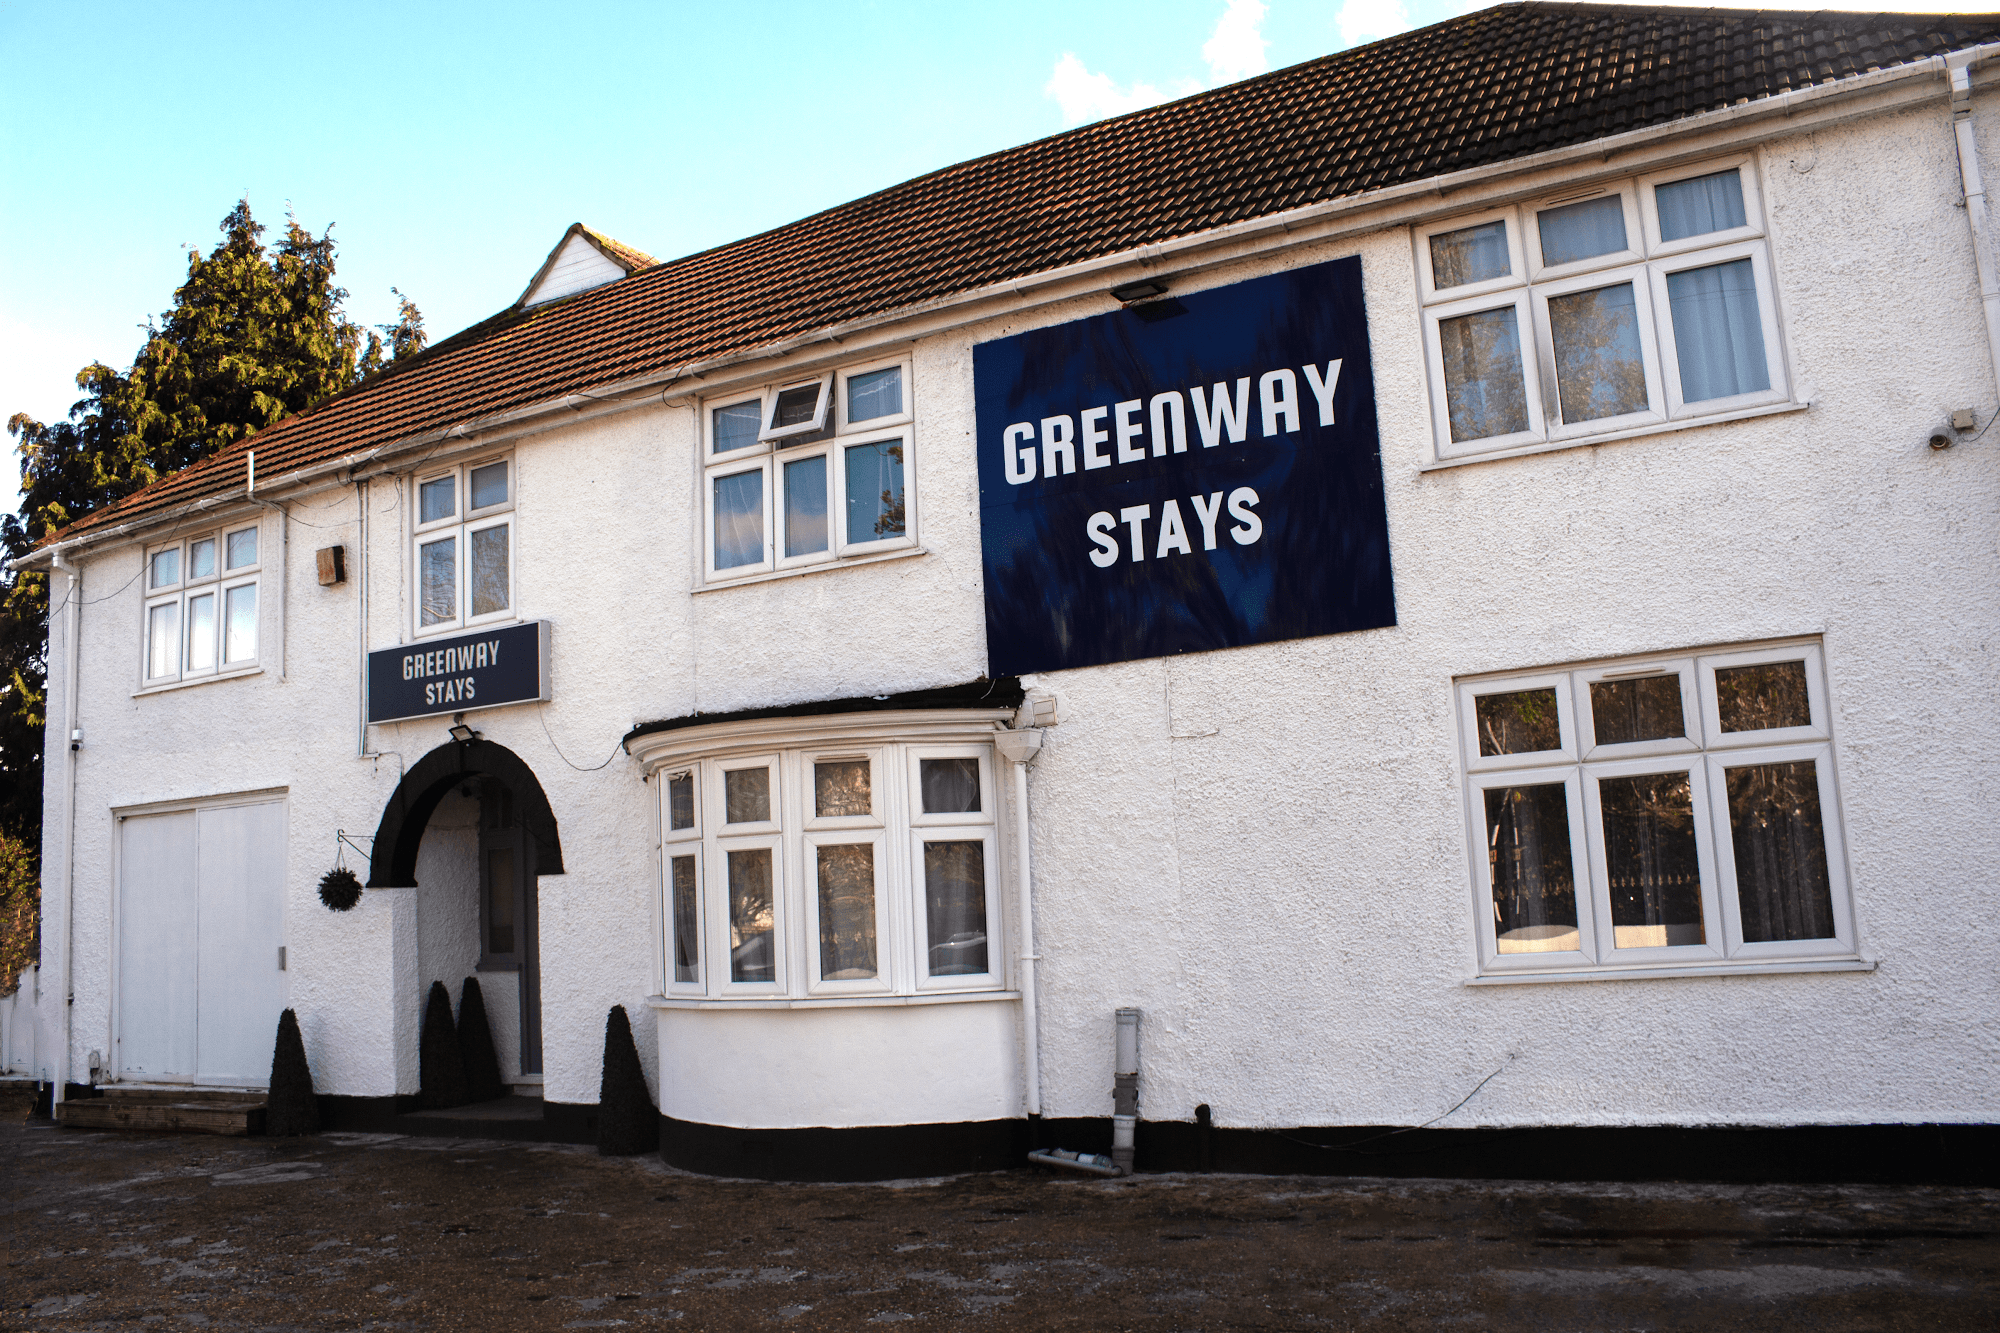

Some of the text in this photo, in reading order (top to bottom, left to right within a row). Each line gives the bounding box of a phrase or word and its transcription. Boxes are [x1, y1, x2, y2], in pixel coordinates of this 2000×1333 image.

[1002, 358, 1343, 485] GREENWAY
[1086, 486, 1263, 568] STAYS
[402, 640, 500, 681] GREENWAY
[425, 677, 475, 706] STAYS
